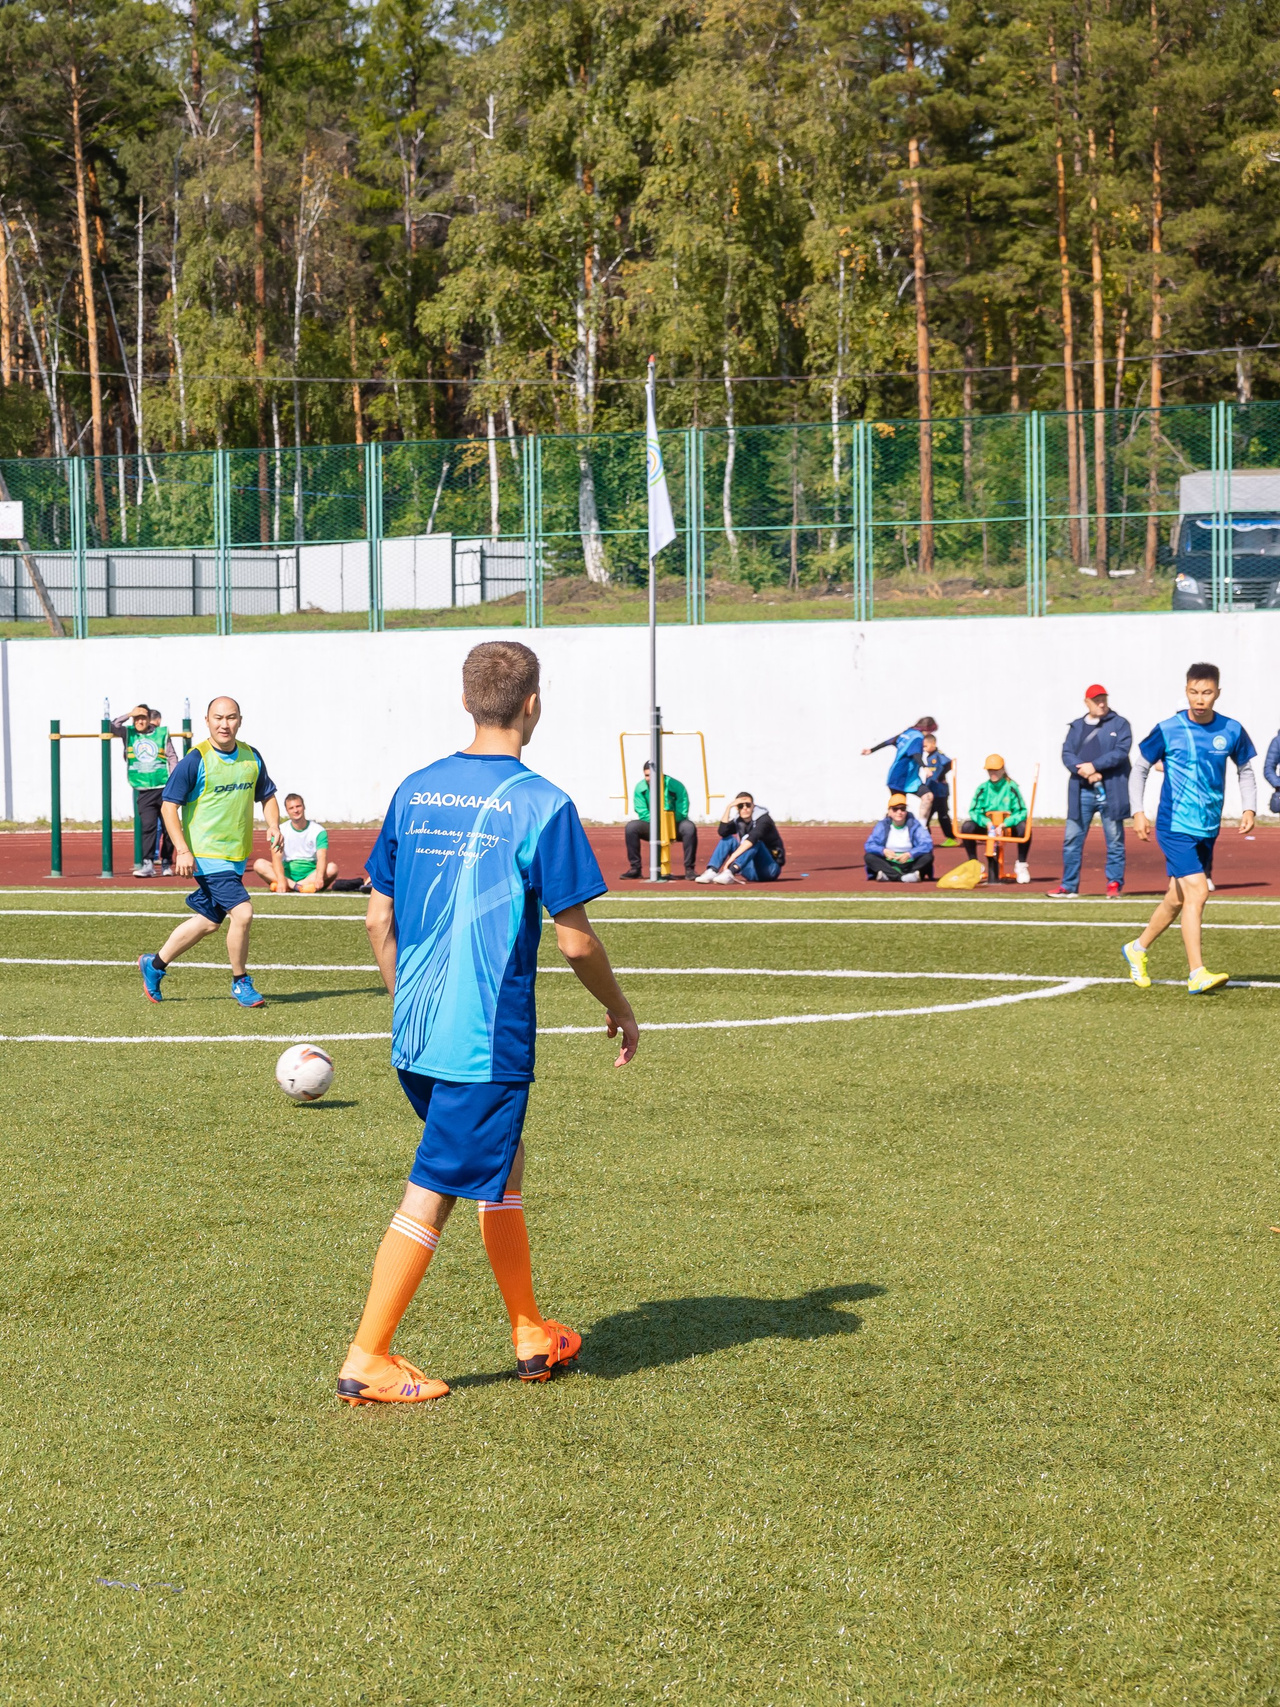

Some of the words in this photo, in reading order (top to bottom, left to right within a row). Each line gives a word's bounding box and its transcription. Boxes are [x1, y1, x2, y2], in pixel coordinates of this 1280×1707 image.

[214, 781, 254, 793] DEMIX
[409, 791, 512, 815] ВОДОКАНАЛ
[405, 819, 464, 844] Любимому
